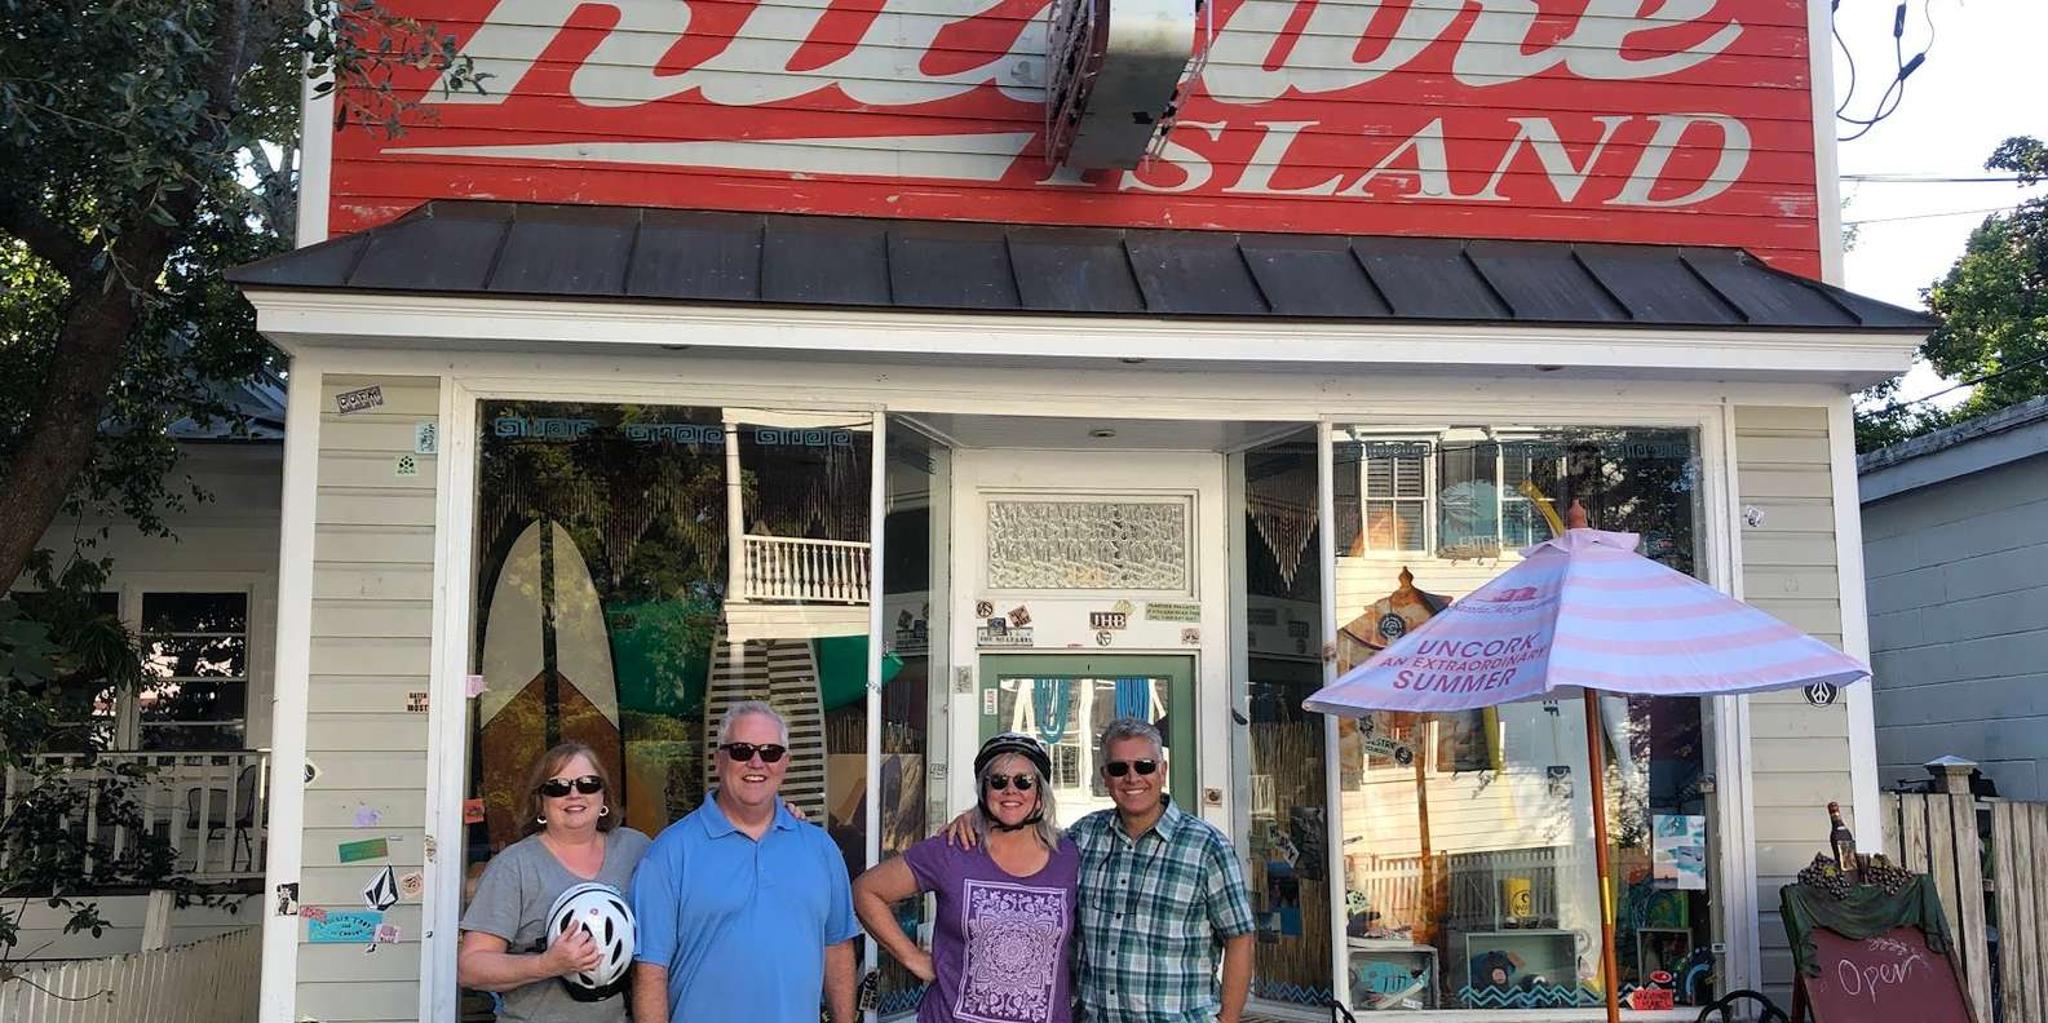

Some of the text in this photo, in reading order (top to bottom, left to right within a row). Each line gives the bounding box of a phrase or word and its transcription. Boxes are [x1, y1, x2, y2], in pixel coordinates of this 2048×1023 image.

[1036, 112, 1753, 208] SLAND
[1380, 646, 1547, 672] AN EXTRAORDINARY
[1417, 633, 1540, 658] UNCORK
[1393, 667, 1517, 694] SUMMER
[1838, 954, 1921, 1003] Open
